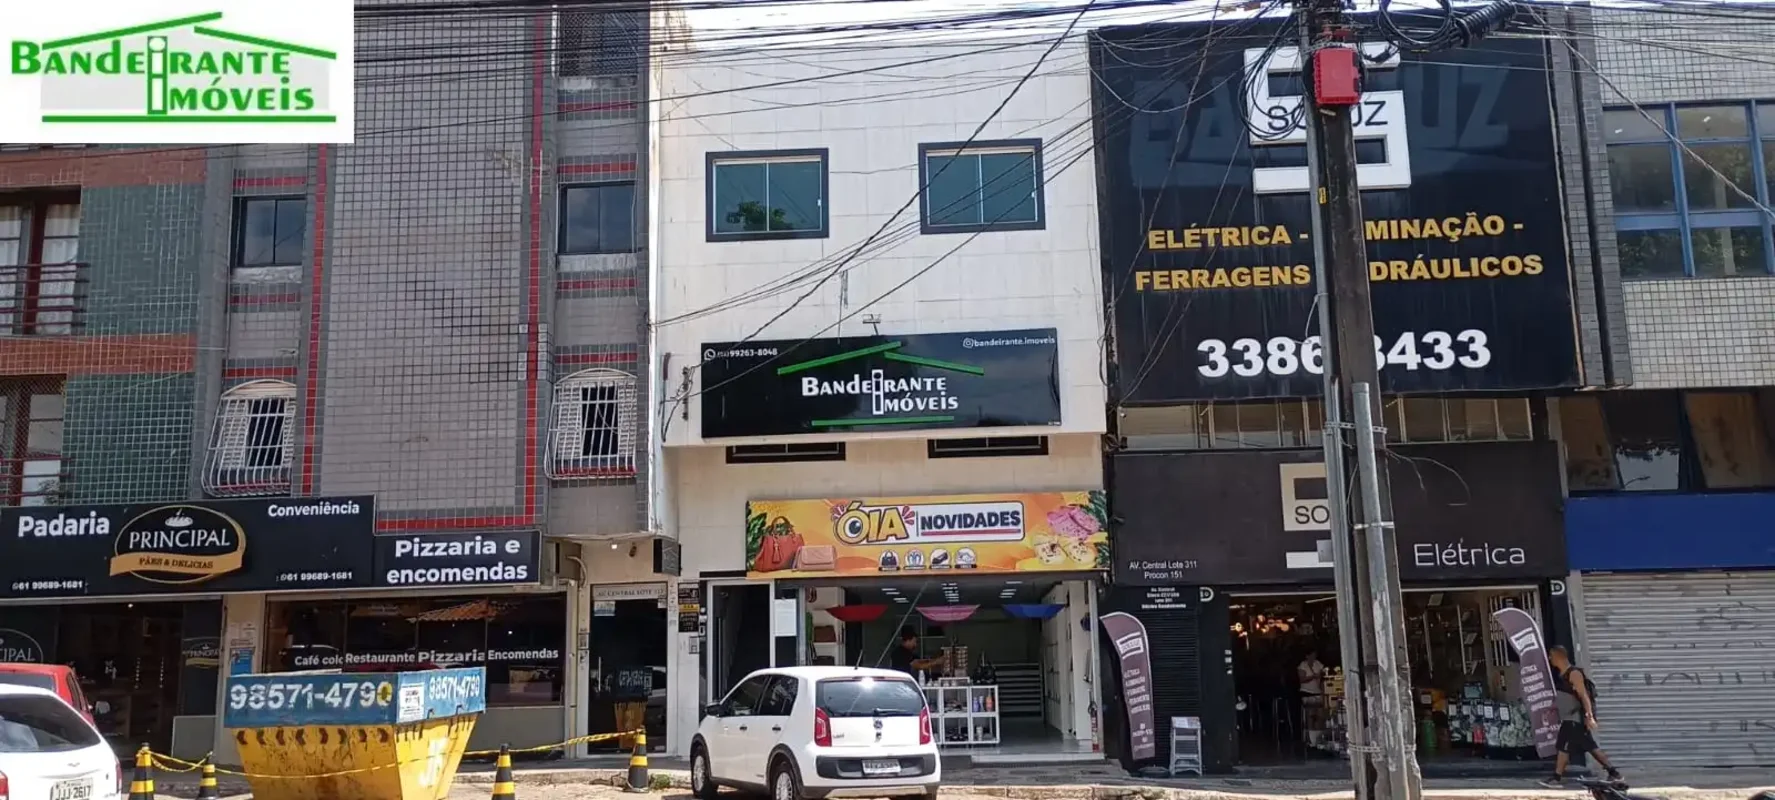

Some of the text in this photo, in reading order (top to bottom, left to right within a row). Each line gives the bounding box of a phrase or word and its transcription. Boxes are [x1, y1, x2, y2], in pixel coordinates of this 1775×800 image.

[1148, 222, 1292, 249] ELÉTRICA
[1135, 264, 1311, 291] FERRAGENS
[268, 500, 360, 518] Conveniência
[18, 510, 110, 538] Padaria
[920, 510, 1021, 531] NOVIDADES
[129, 528, 231, 549] PRINCIPAL
[395, 535, 521, 557] Pizzaria e
[1184, 560, 1197, 568] 311
[1413, 541, 1526, 567] Elétrica
[386, 561, 528, 584] encomendas
[294, 652, 319, 667] Café
[345, 652, 415, 664] Restaurante
[418, 649, 485, 663] Pizzaria
[488, 648, 558, 661] Encomendas
[230, 681, 392, 710] 98571-4790
[428, 675, 480, 700] 98571-4790
